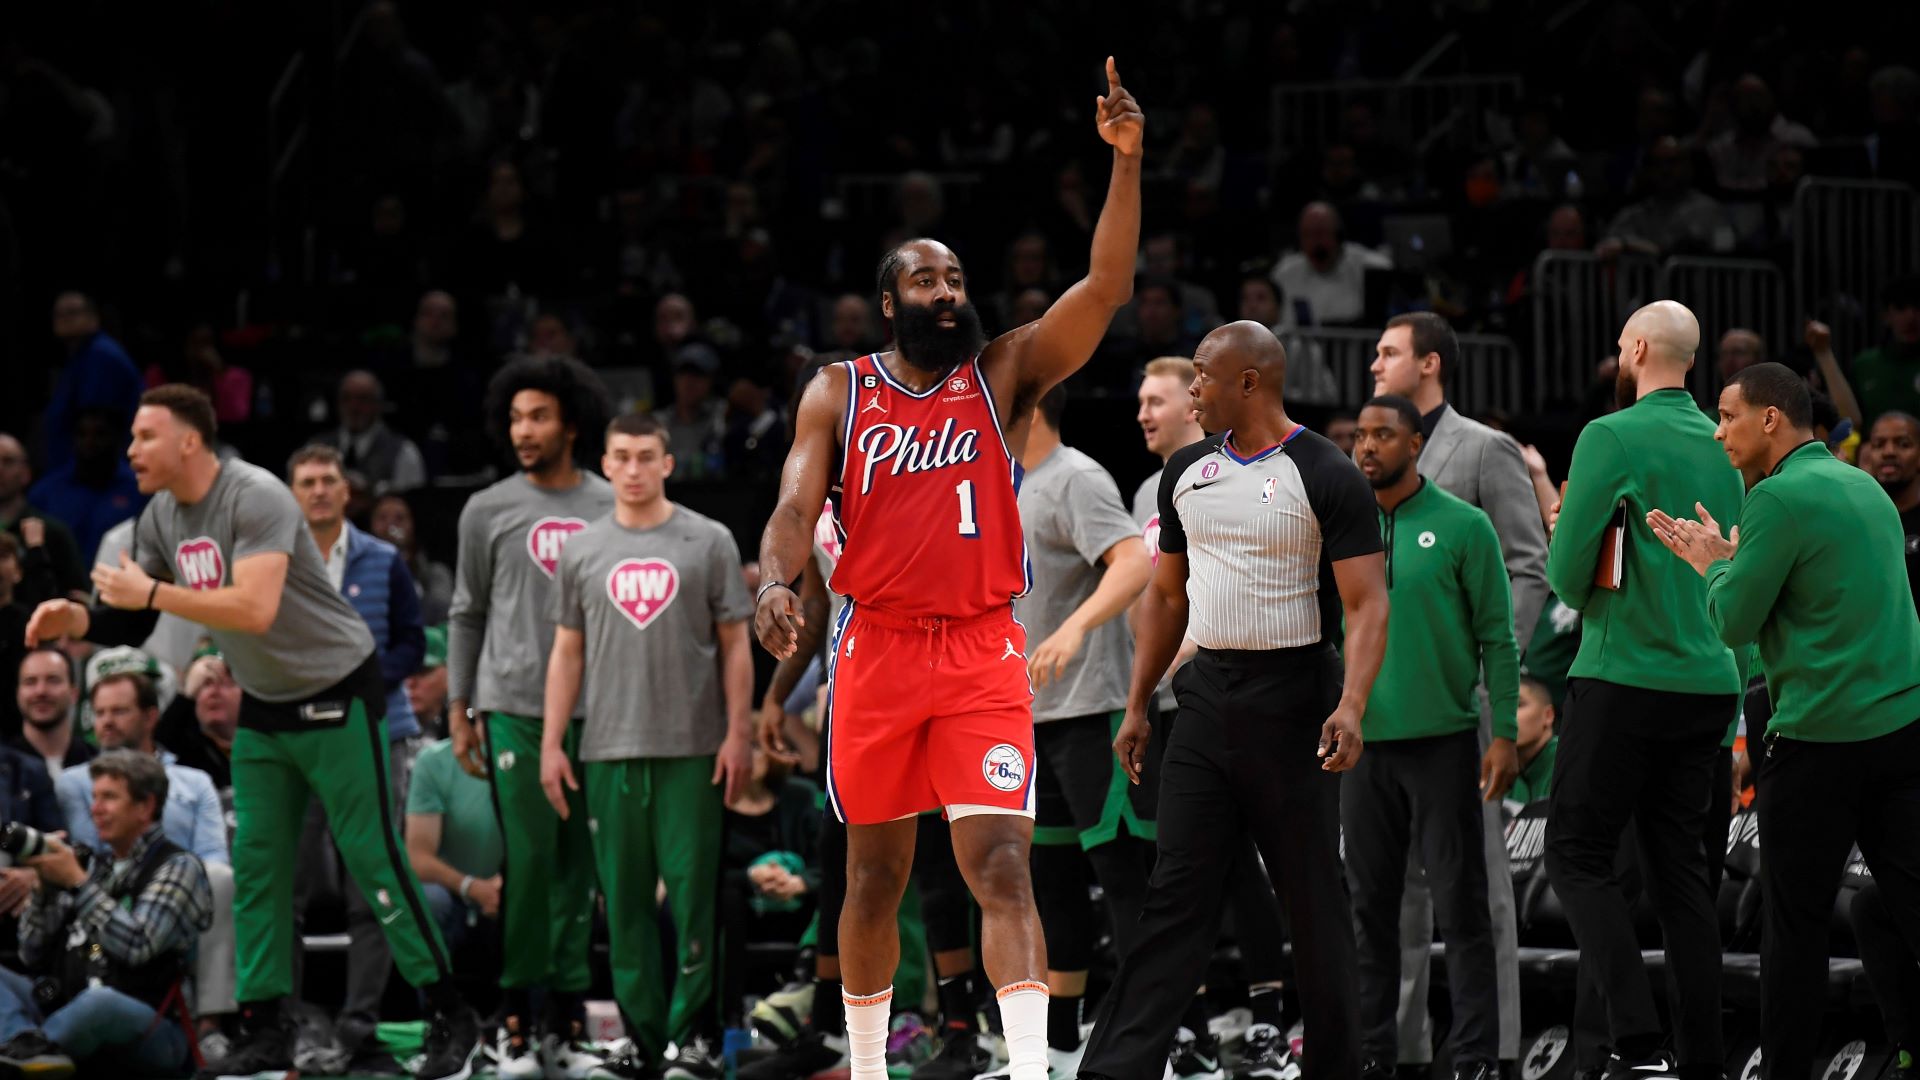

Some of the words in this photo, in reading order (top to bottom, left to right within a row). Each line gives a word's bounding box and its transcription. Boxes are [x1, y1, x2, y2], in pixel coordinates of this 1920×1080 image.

[864, 375, 877, 389] 6
[941, 392, 981, 403] crypto.com
[857, 417, 981, 495] Phila
[955, 479, 981, 539] 1
[537, 528, 569, 561] H
[180, 548, 218, 585] HW
[616, 568, 671, 602] HW
[988, 760, 1021, 781] 76ers
[1506, 817, 1548, 860] PLAYO
